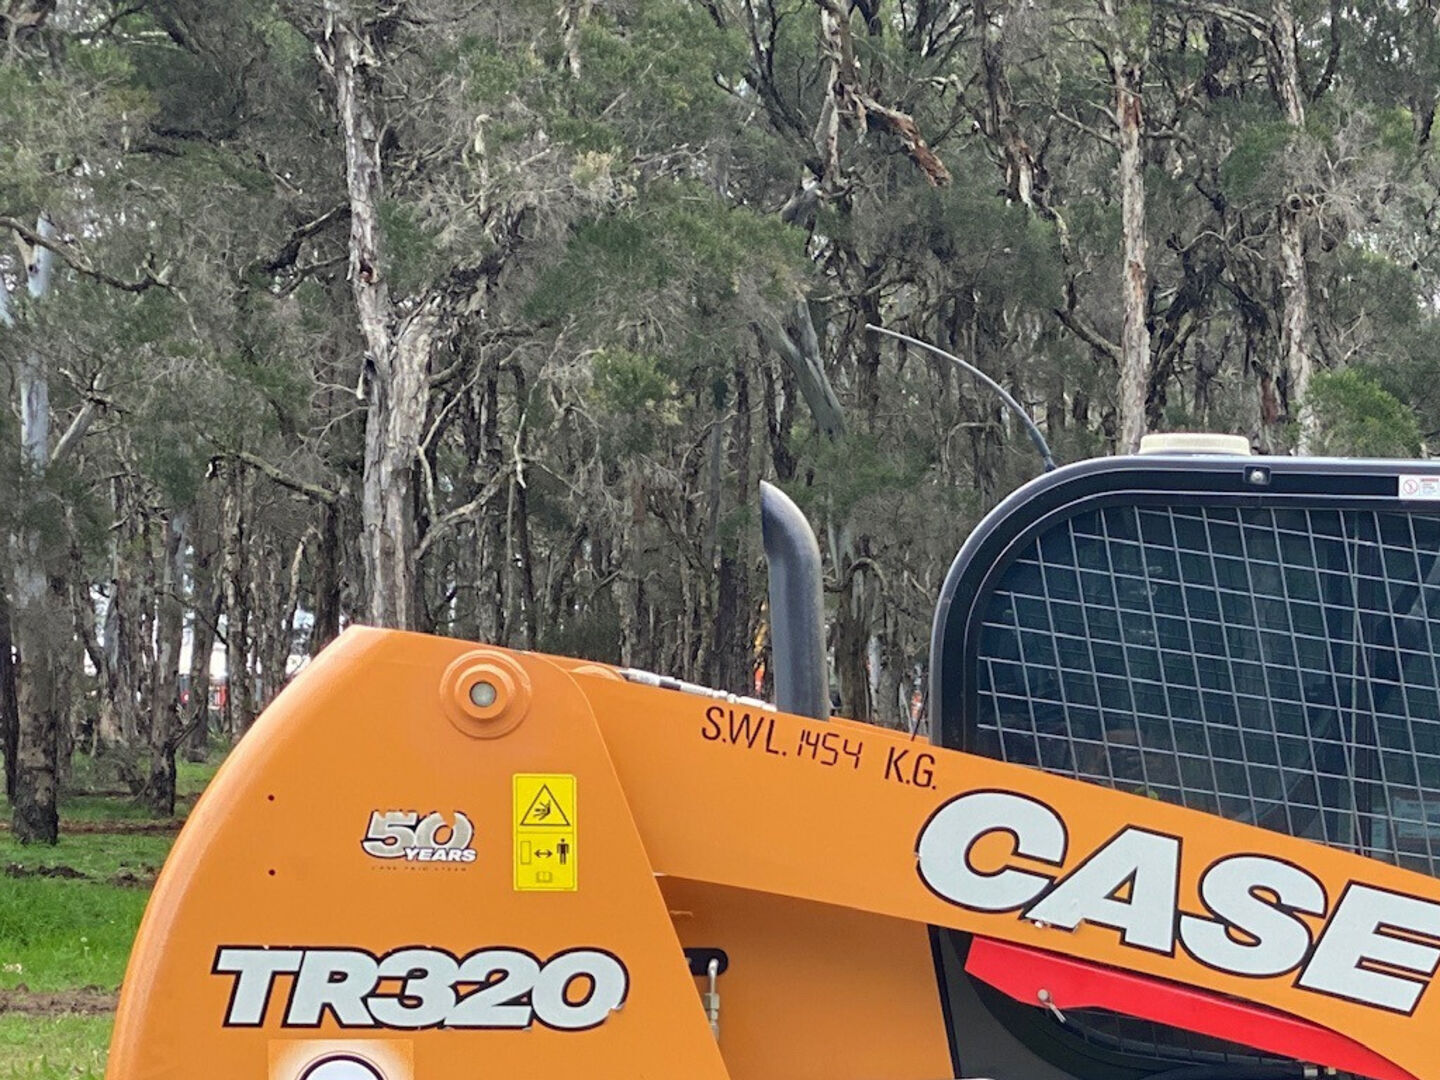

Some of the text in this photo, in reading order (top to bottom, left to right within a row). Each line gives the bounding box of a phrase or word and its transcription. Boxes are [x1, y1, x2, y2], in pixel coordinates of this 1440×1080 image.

[797, 729, 863, 769] 1454
[884, 746, 937, 790] K.G.
[360, 809, 474, 858] 50
[404, 846, 477, 862] YEARS
[212, 945, 629, 1031] TR320
